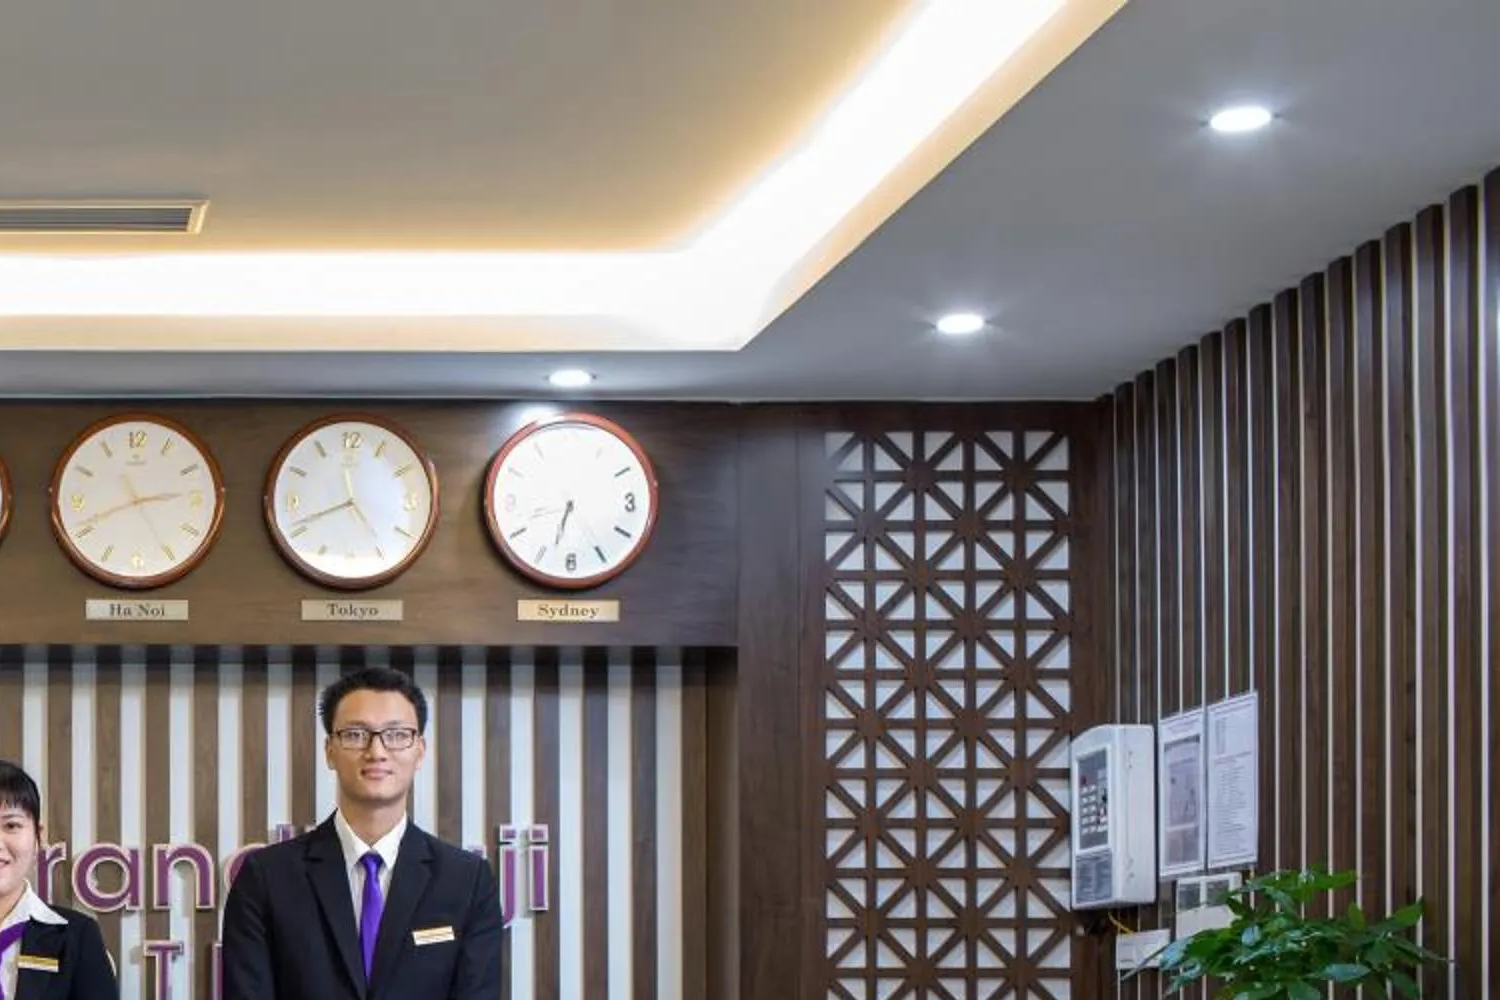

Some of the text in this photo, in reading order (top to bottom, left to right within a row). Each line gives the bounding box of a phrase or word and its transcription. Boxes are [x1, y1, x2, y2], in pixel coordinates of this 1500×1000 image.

[624, 492, 636, 512] 3
[110, 603, 166, 617] Ha Noi
[327, 603, 379, 619] Tokyo
[537, 603, 599, 619] Sydney
